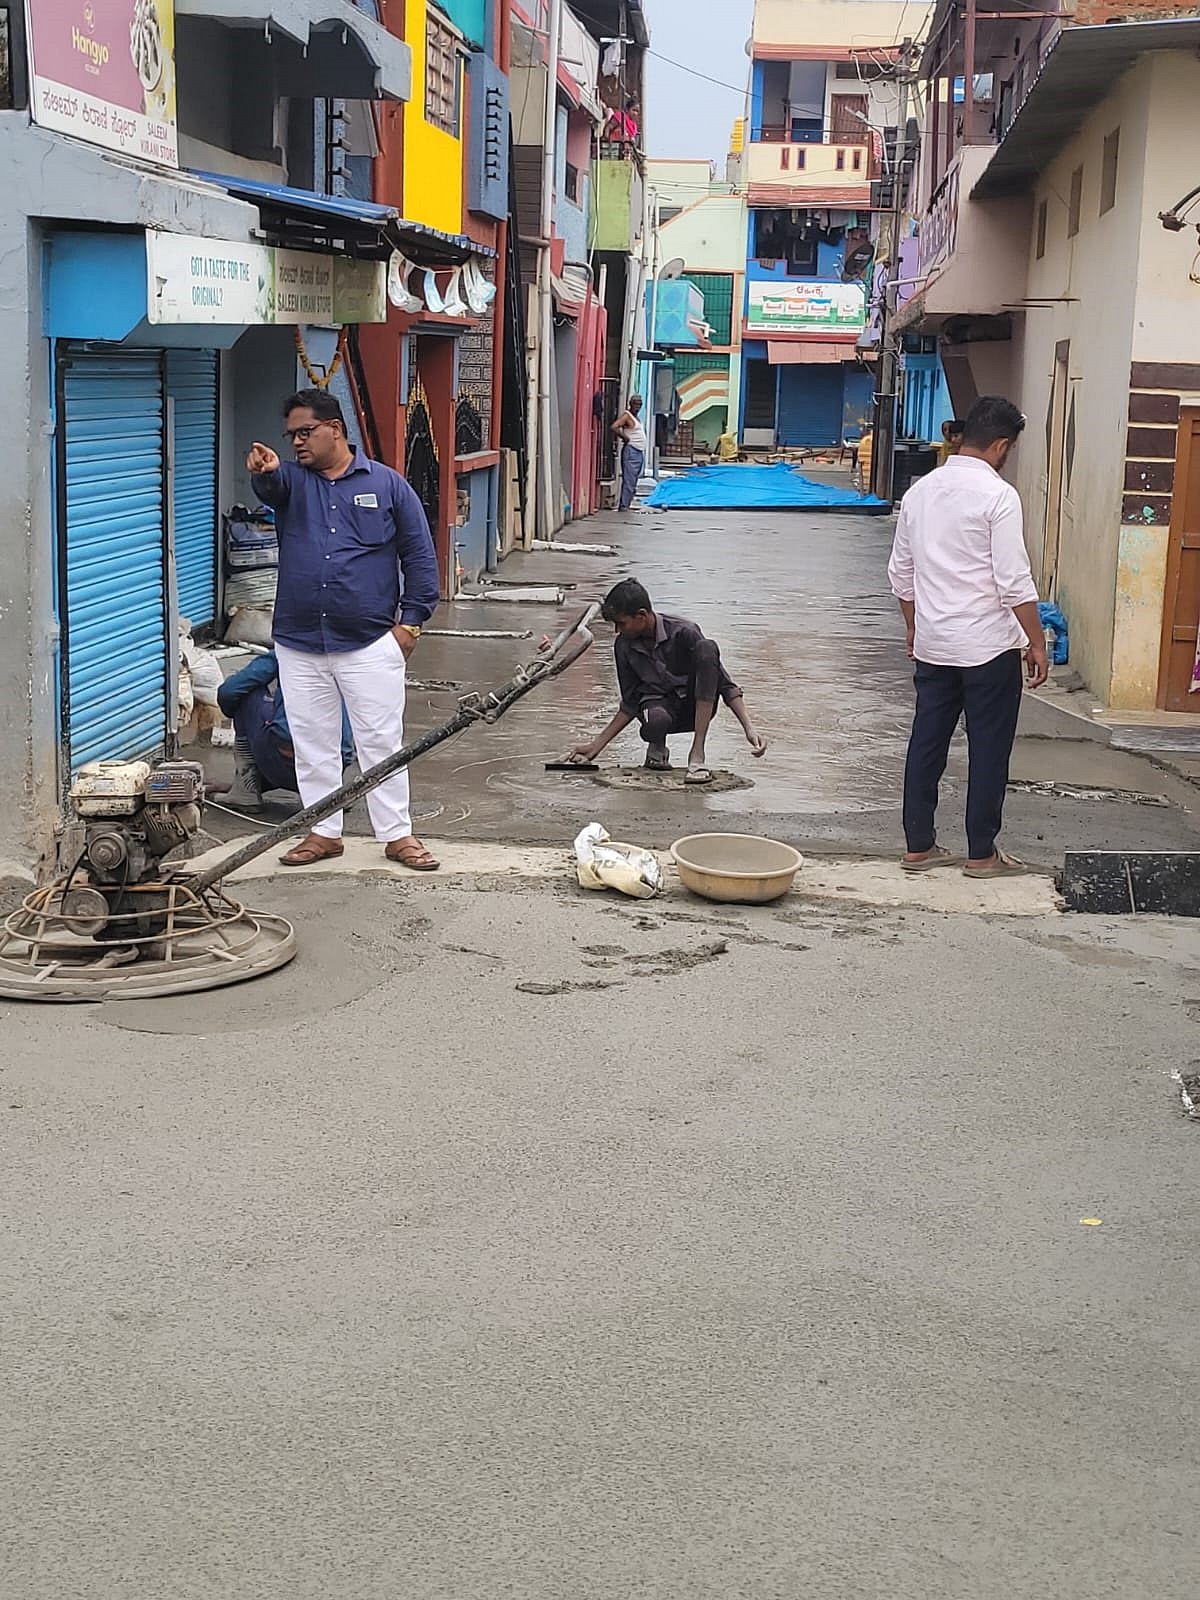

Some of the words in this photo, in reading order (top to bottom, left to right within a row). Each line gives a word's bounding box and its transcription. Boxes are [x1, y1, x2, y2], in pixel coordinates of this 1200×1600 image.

[72, 25, 109, 66] Hangyo
[147, 121, 168, 140] SALEEM
[141, 139, 160, 158] KIRANI
[160, 144, 177, 163] STORE
[191, 256, 203, 276] GOT
[204, 257, 209, 278] A
[209, 258, 226, 279] TASTE
[227, 260, 238, 280] FOR
[239, 262, 250, 282] THE
[192, 286, 224, 306] ORIGINAL?
[278, 292, 298, 312] SALEEM
[300, 294, 316, 312] KIRANI
[317, 295, 331, 313] STORE
